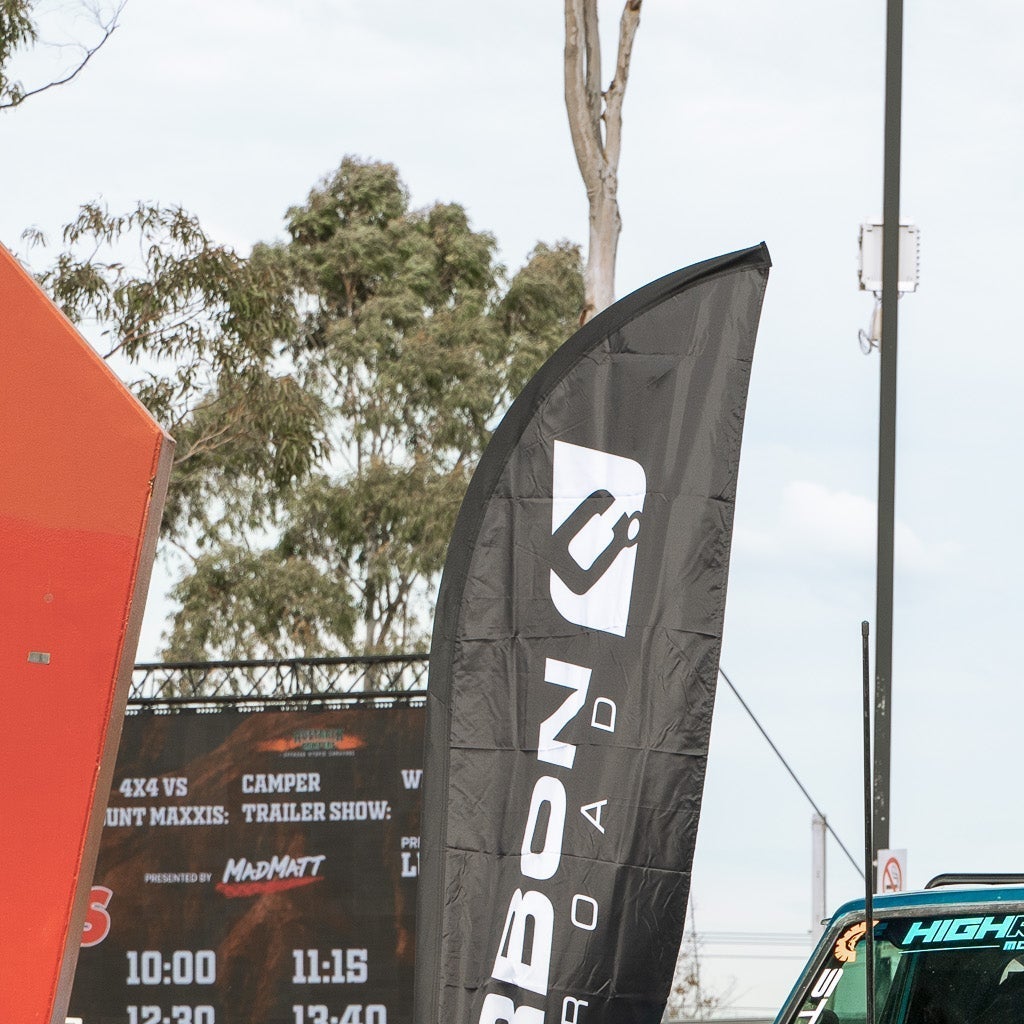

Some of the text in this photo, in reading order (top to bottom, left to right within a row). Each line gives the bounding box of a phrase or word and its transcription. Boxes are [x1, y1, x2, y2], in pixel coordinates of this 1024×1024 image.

[119, 777, 188, 798] 4X4 VS
[241, 772, 321, 794] CAMPER
[150, 805, 229, 826] MAXXIS:
[241, 801, 392, 823] TRAILER SHOW:
[144, 872, 213, 884] PRESENTED BY
[126, 949, 368, 985] 10:00 11:15
